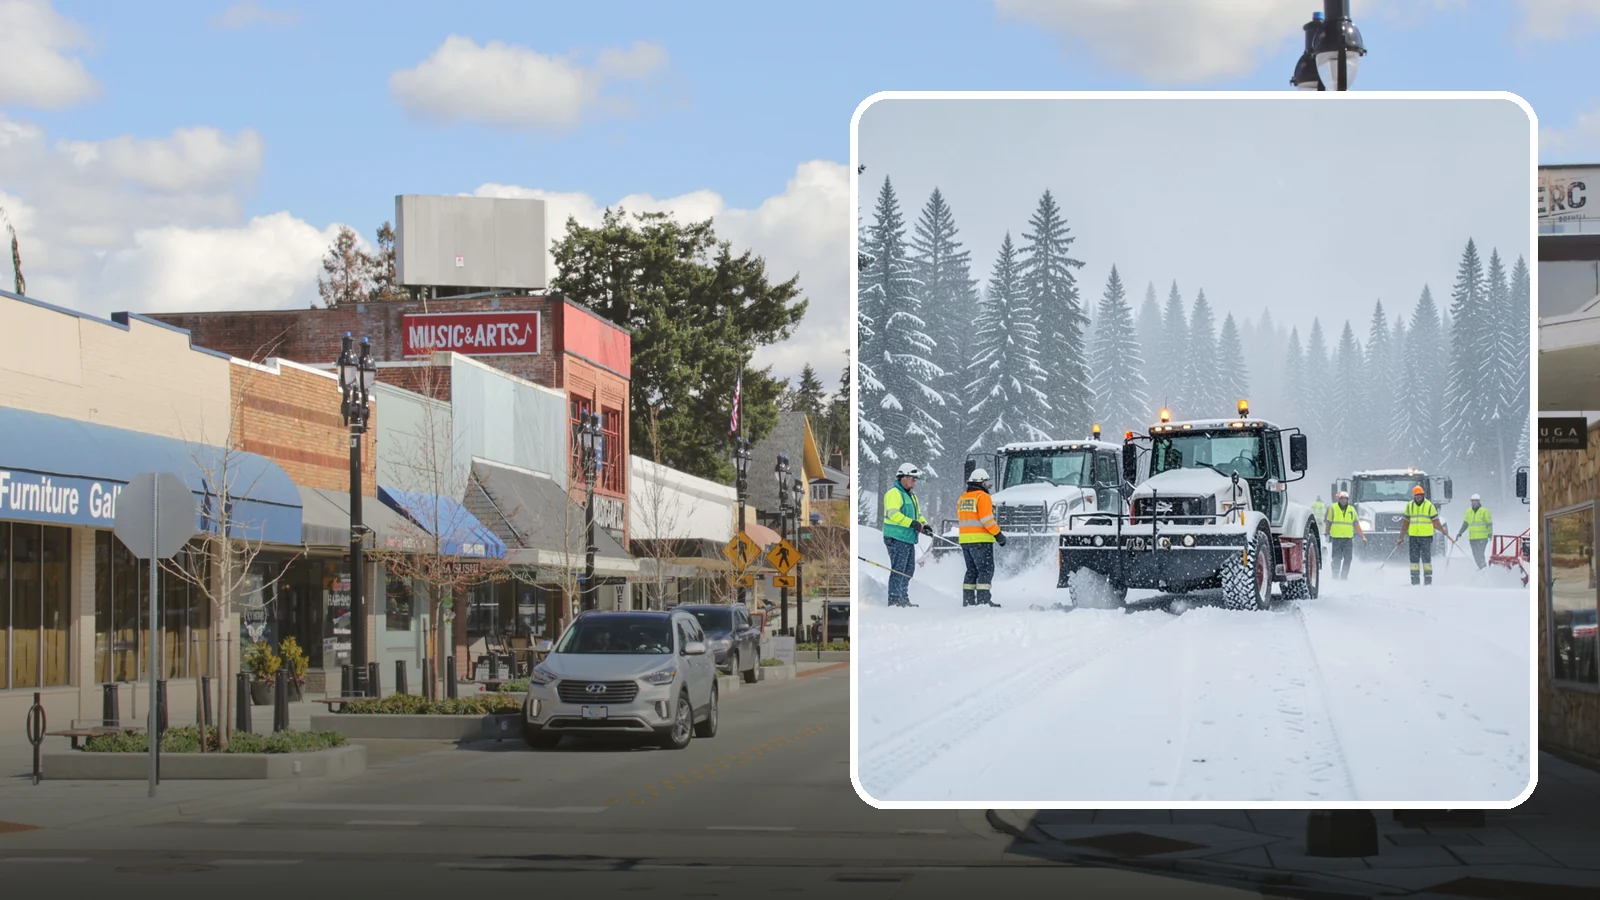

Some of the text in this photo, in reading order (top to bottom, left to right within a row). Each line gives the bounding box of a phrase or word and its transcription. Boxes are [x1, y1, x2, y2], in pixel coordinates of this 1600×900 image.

[0, 471, 122, 519] Furniture Gal
[453, 563, 479, 574] SUSHI
